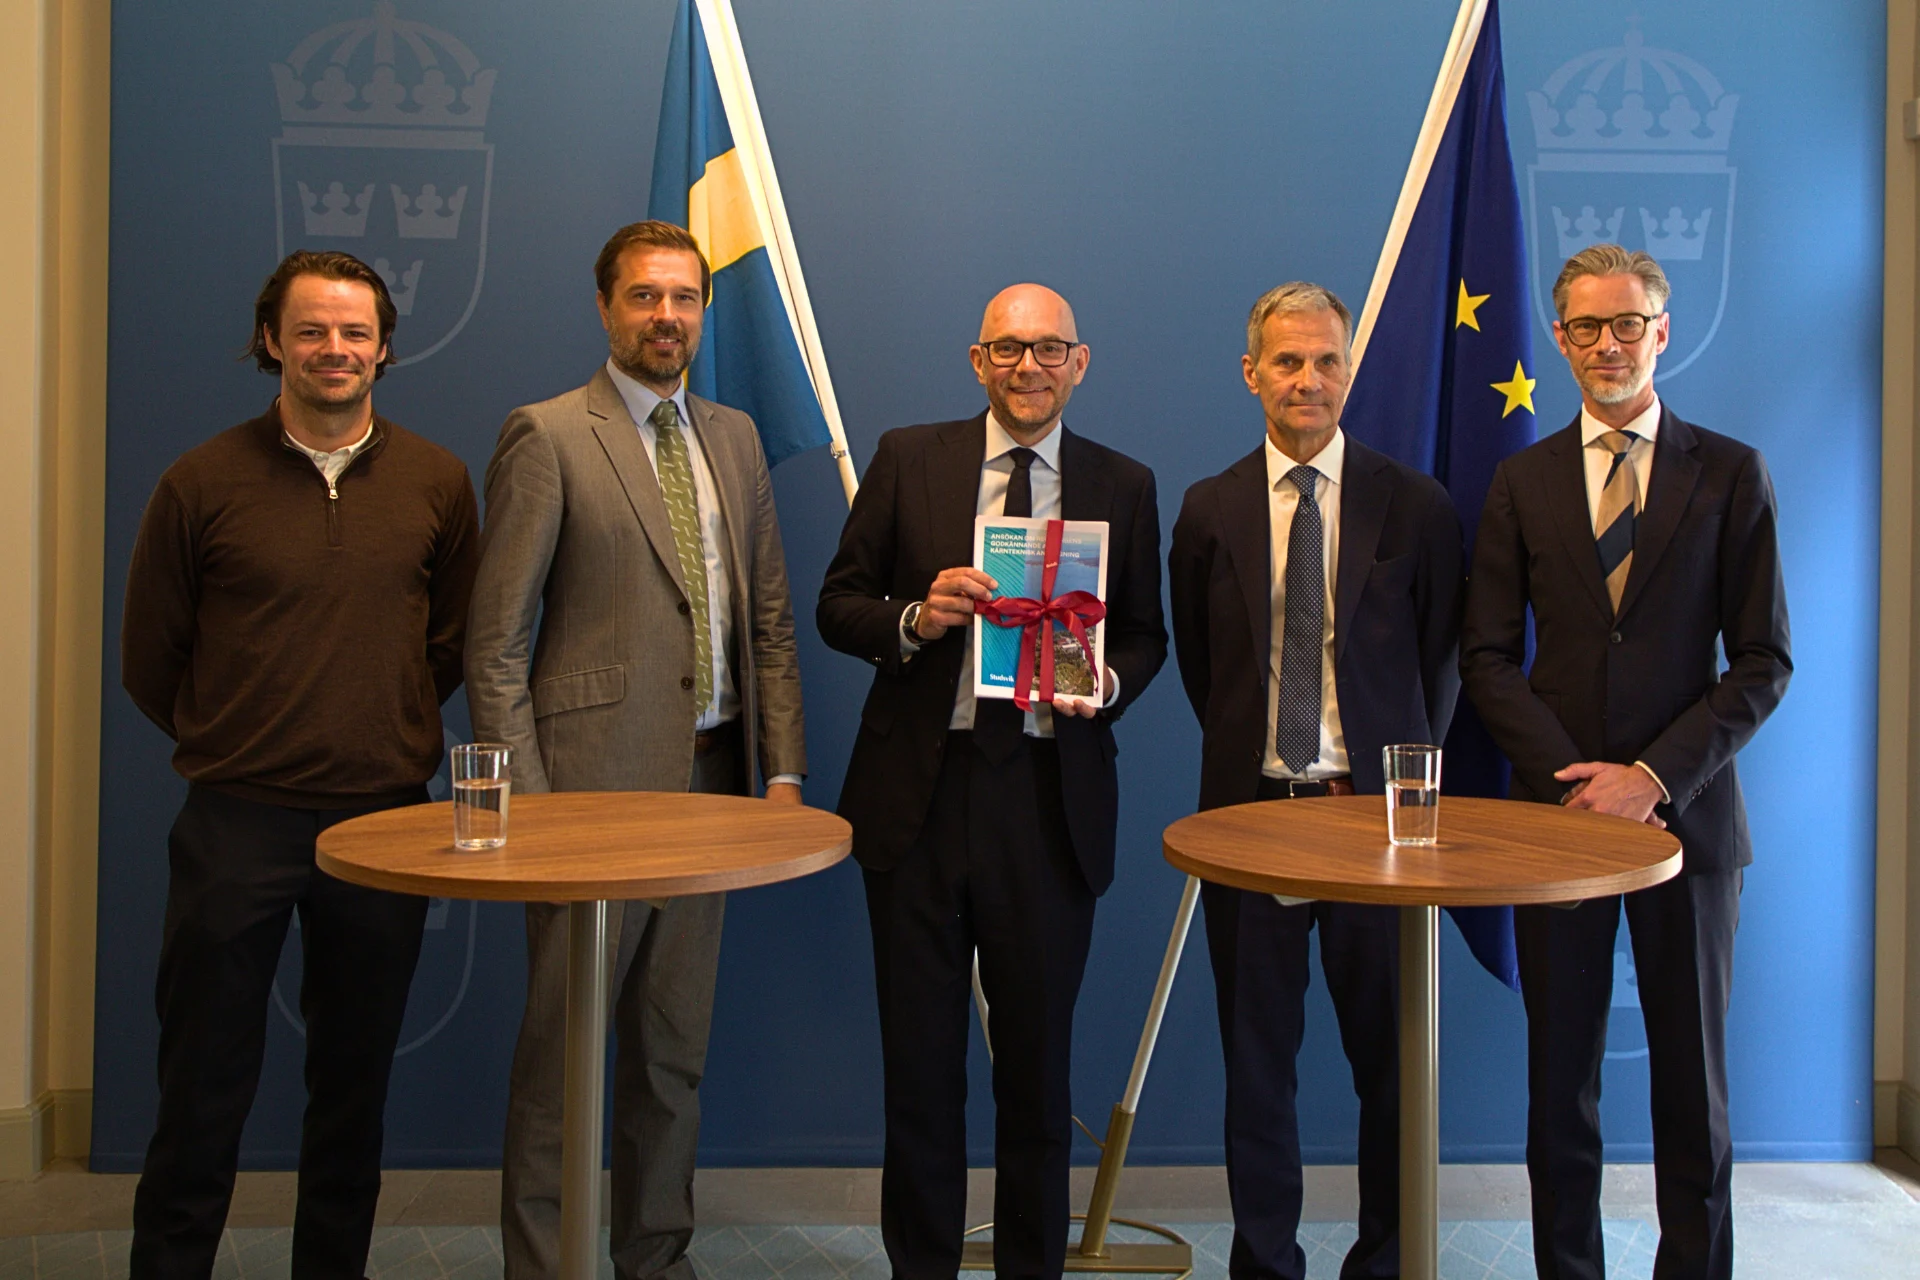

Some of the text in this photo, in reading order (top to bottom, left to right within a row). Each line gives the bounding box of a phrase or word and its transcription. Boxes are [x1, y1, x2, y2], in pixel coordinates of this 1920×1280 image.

[991, 533, 1024, 541] ANSÖKAN
[990, 540, 1041, 549] GODKÄNNANDE
[990, 673, 1014, 682] Studsvik
